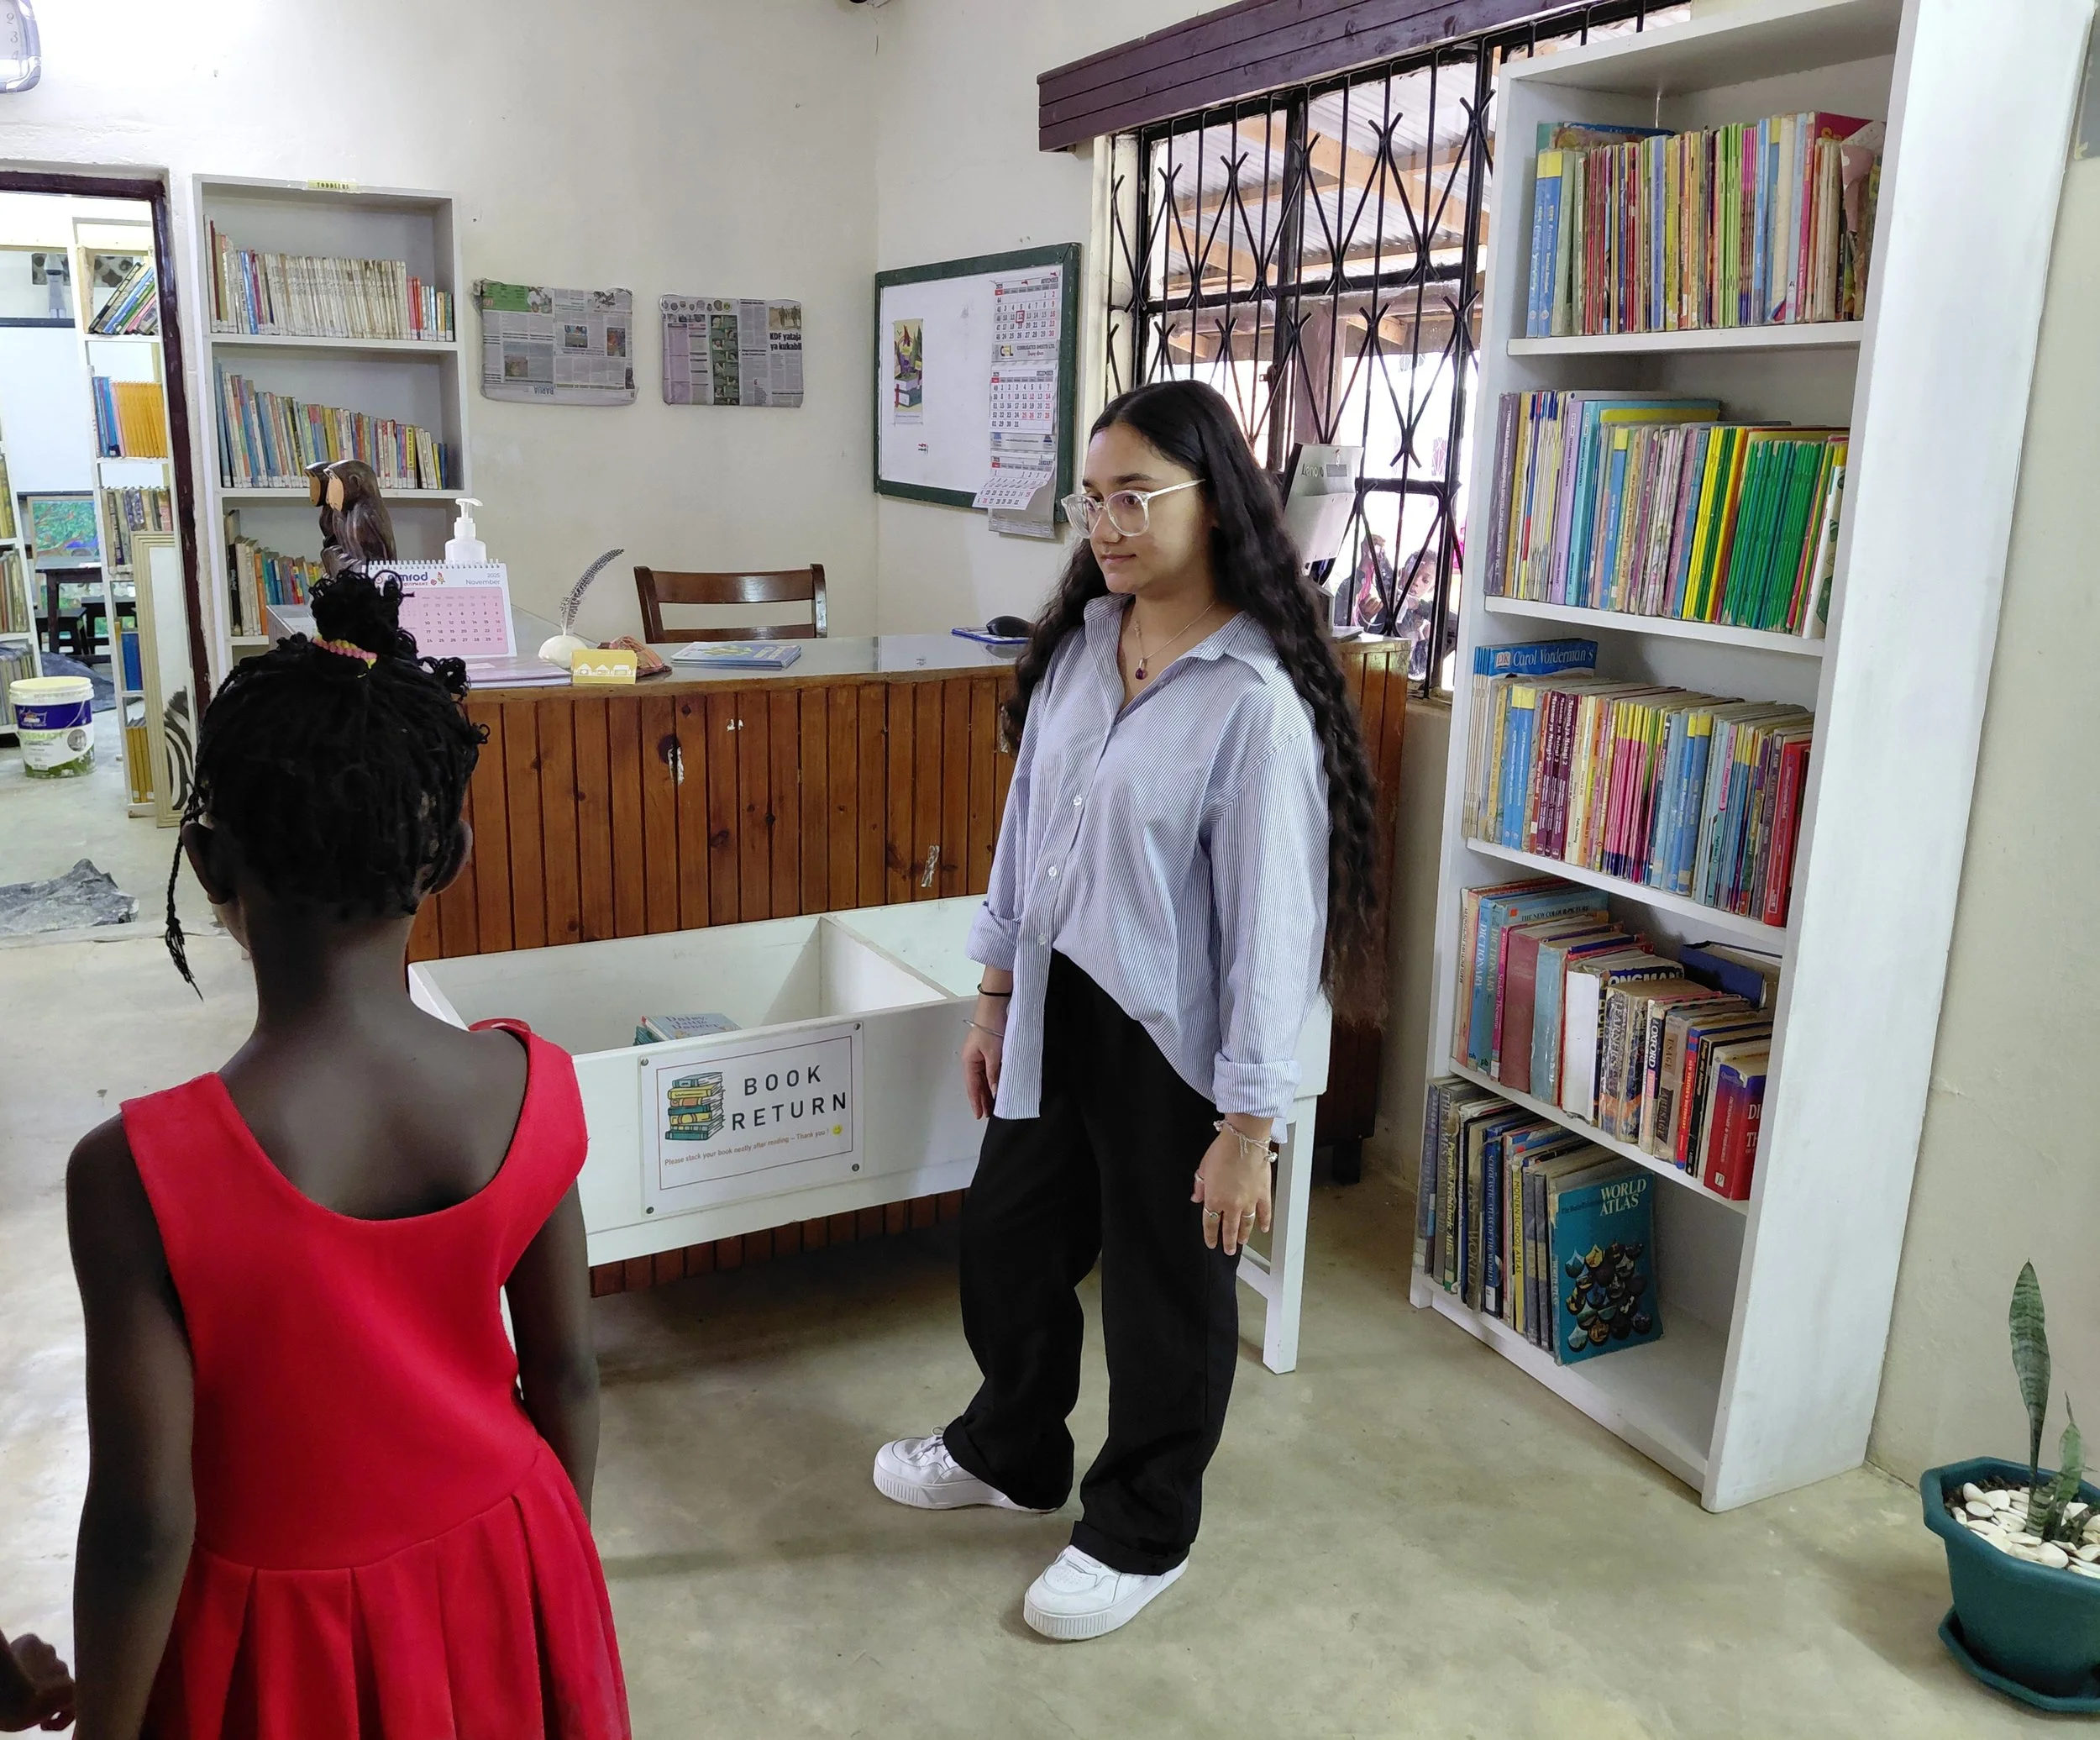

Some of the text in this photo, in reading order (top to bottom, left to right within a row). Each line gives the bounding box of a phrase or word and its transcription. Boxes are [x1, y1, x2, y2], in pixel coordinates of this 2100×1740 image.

[7, 13, 14, 24] 2
[10, 31, 18, 44] 3
[769, 332, 782, 340] KDF
[387, 571, 428, 581] mrod
[1497, 646, 1593, 666] DK Carol Vorderman's
[1566, 699, 1574, 726] Masomo
[1474, 924, 1487, 987] DICTIONARY
[1487, 928, 1499, 992] DICTIONARY
[1496, 974, 1504, 1000] Student
[1602, 971, 1683, 987] ONGMAN
[1648, 1025, 1659, 1068] OXFORD
[1664, 1038, 1675, 1070] USAGE
[744, 1065, 821, 1096] BOOK
[732, 1092, 847, 1131] RETURN
[1657, 1090, 1670, 1140] ABUSAGE
[1748, 1104, 1762, 1120] DI
[664, 1157, 685, 1166] Please
[685, 1154, 701, 1164] stack
[703, 1151, 717, 1159] your
[718, 1148, 732, 1156] book
[734, 1144, 752, 1153] neatly
[753, 1141, 767, 1149] after
[768, 1137, 790, 1146] reading
[796, 1133, 814, 1141] Thank
[1488, 1154, 1496, 1200] SCHOLASTIC
[1600, 1178, 1647, 1201] WORLD
[1446, 1180, 1455, 1231] Prehistoric
[1513, 1180, 1521, 1217] MODERN
[1600, 1194, 1640, 1216] ATLAS
[1445, 1232, 1454, 1256] Atlas
[1514, 1217, 1522, 1245] SCHOOL
